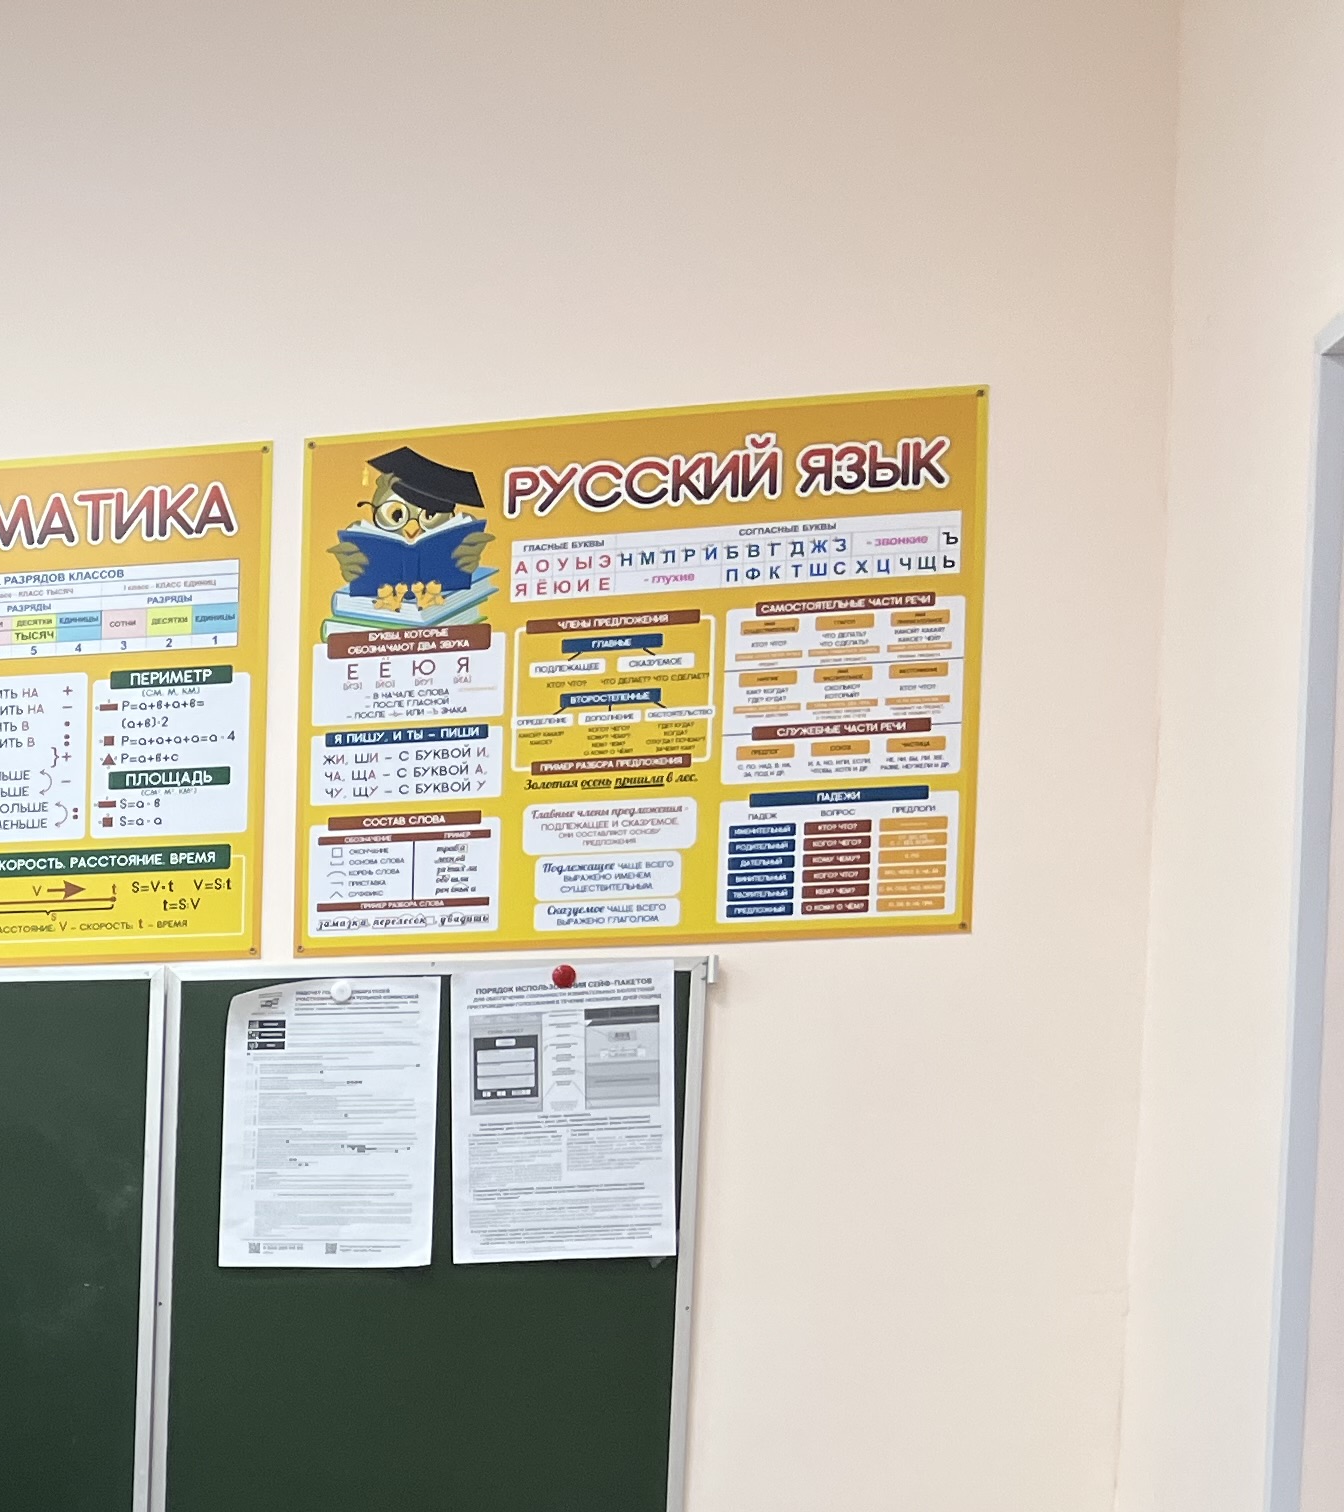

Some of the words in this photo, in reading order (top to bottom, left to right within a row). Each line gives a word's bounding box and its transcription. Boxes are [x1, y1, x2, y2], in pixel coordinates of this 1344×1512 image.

[508, 437, 779, 514] РУССКИЙ
[799, 439, 946, 493] ЯЗЫК
[738, 525, 799, 536] СОГЛАСНЫЕ
[802, 522, 836, 532] БУКВЫ
[523, 542, 568, 552] ГЛАСНЫЕ
[571, 540, 605, 549] БУКВЫ
[3, 573, 65, 585] РАЗРЯДОВ
[69, 569, 124, 581] КЛАССОВ
[762, 599, 865, 613] САМОСТОЯТЕЛЬНЫЕ
[868, 597, 903, 607] ЧАСТИ
[905, 595, 931, 604] РЕЧИ
[557, 619, 591, 630] ЧЛЕНЫ
[593, 614, 669, 628] ПРЕДЛОЖЕНИЯ
[15, 631, 54, 641] ТЫСЯЧ
[348, 643, 415, 655] ОБОЗНАЧАЮТ
[440, 640, 470, 649] ЗВУКА
[130, 670, 212, 685] ПЕРИМЕТР
[22, 688, 38, 699] НА
[28, 704, 44, 714] НА
[22, 721, 29, 731] В
[777, 726, 840, 736] СЛУЖЕБНЫЕ
[844, 724, 879, 733] ЧАСТИ
[881, 722, 907, 731] РЕЧИ
[27, 737, 35, 748] В
[335, 735, 342, 744] Я
[393, 732, 402, 741] И
[407, 730, 423, 740] ТЫ
[441, 727, 480, 738] ПИШИ
[355, 753, 379, 764] ШИ
[399, 751, 409, 761] С
[415, 745, 471, 760] БУКВОЙ
[352, 769, 376, 781] ЩА
[397, 768, 407, 778] С
[414, 761, 469, 777] БУКВОЙ
[125, 771, 212, 787] ПЛОЩАДЬ
[524, 780, 578, 790] Золотая
[581, 779, 612, 787] осень
[615, 775, 664, 786] пришла
[666, 772, 673, 783] в
[353, 786, 378, 797] ЩУ
[399, 785, 410, 794] С
[416, 778, 471, 794] БУКВОЙ
[477, 781, 486, 790] У
[817, 791, 861, 802] ПАДЕЖИ
[363, 818, 405, 827] СОСТАВ
[409, 815, 445, 824] СЛОВА
[169, 852, 216, 864] ВРЕМЯ
